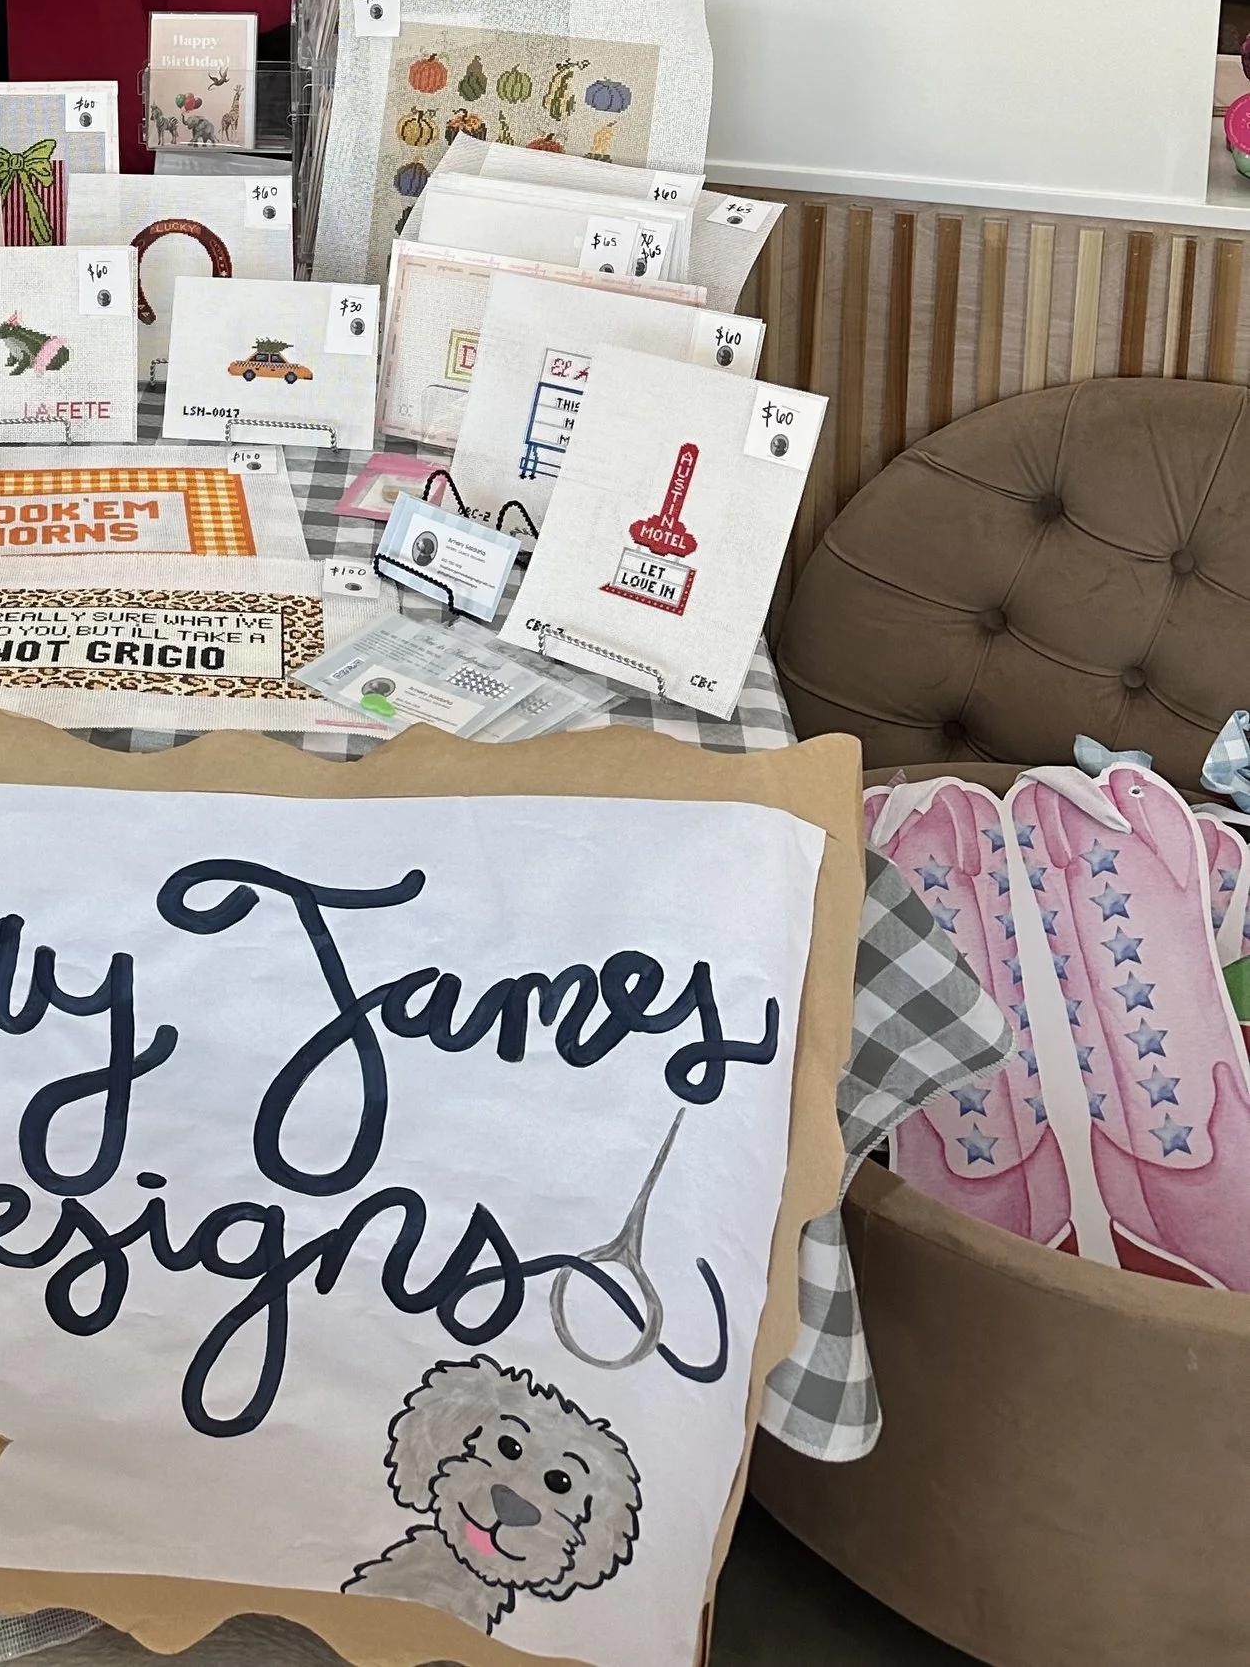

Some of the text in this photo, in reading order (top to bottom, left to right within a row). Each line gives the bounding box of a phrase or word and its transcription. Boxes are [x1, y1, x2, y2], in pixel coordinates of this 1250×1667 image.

[173, 34, 220, 48] Happy
[162, 54, 230, 69] Birthday!
[73, 96, 95, 111] $60
[252, 186, 278, 200] $60
[654, 187, 677, 201] $60
[155, 222, 199, 233] LUCKY
[86, 263, 108, 282] $60
[340, 298, 362, 316] $30
[715, 326, 742, 346] $60
[56, 401, 111, 419] FETE
[761, 400, 794, 428] $60
[661, 451, 694, 529] AUSTIN
[639, 524, 687, 550] MOTEL
[640, 562, 666, 580] LET
[620, 572, 677, 600] LOVE IN
[92, 611, 157, 624] SURE
[163, 614, 229, 627] WHAT
[76, 625, 125, 637] BUT
[177, 630, 243, 644] TAKE
[249, 633, 266, 644] A
[86, 640, 226, 670] GRIGIO
[156, 858, 780, 1197] James
